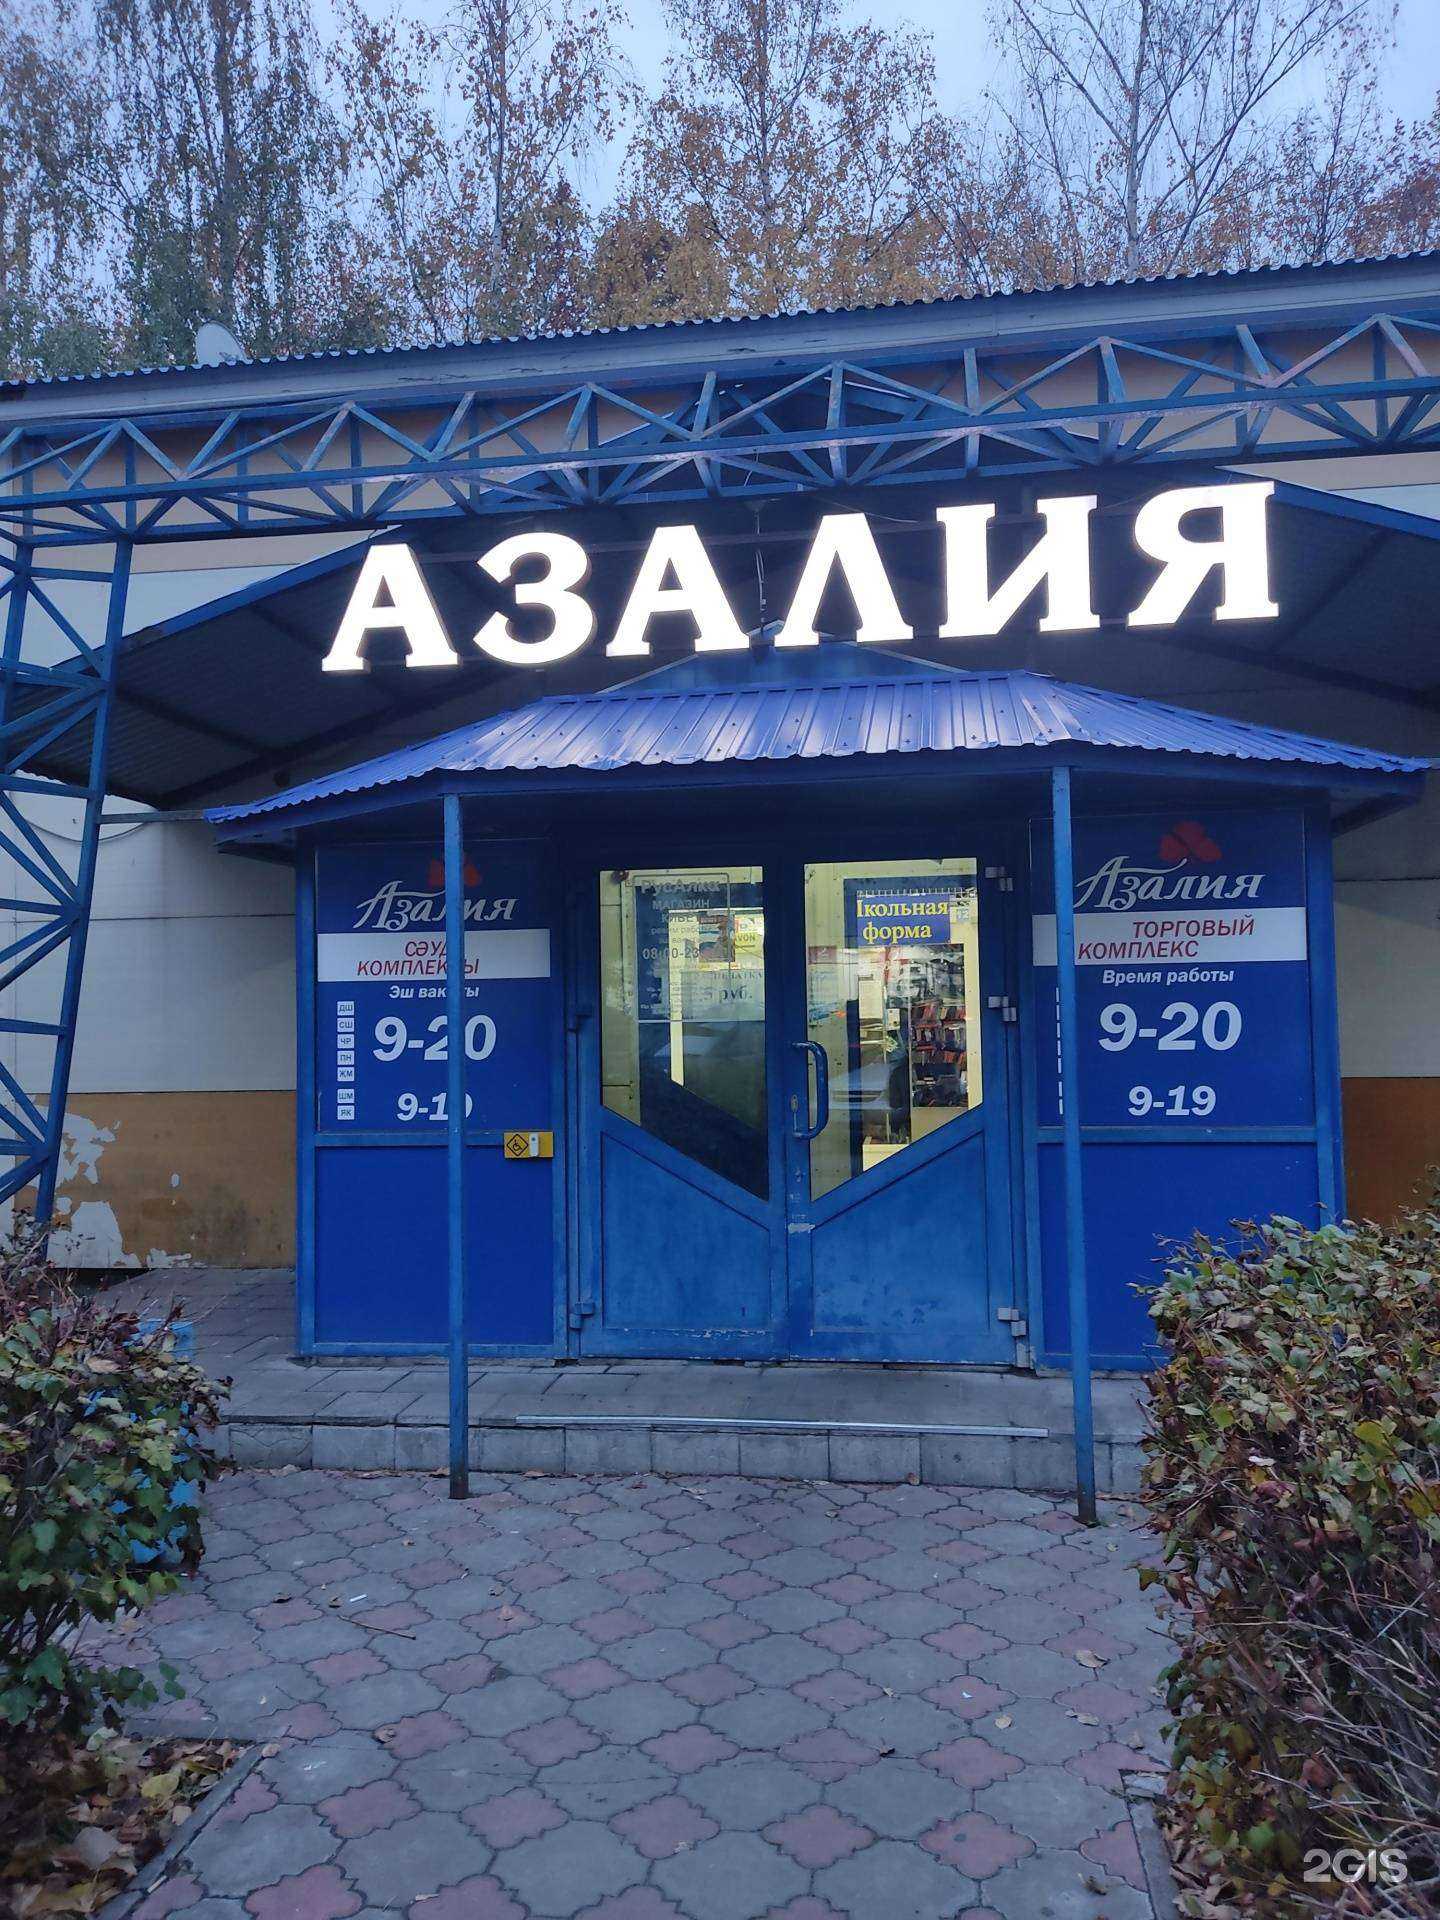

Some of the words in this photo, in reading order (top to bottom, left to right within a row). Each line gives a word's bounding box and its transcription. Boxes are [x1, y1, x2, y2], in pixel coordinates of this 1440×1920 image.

[321, 480, 1279, 673] АЗАЛИЯ
[1073, 856, 1266, 910] Азалия
[863, 922, 932, 943] форма
[1132, 914, 1255, 938] ТОРГОВЫЙ
[1077, 940, 1200, 960] КОМПЛЕКС
[357, 958, 480, 977] КОМПЛЕКЫ
[1102, 969, 1162, 986] Время
[1166, 968, 1235, 986] работы
[389, 985, 414, 999] Эш
[338, 1020, 354, 1030] СШ
[1099, 1001, 1243, 1051] 9-20
[1127, 1085, 1217, 1116] 9-19
